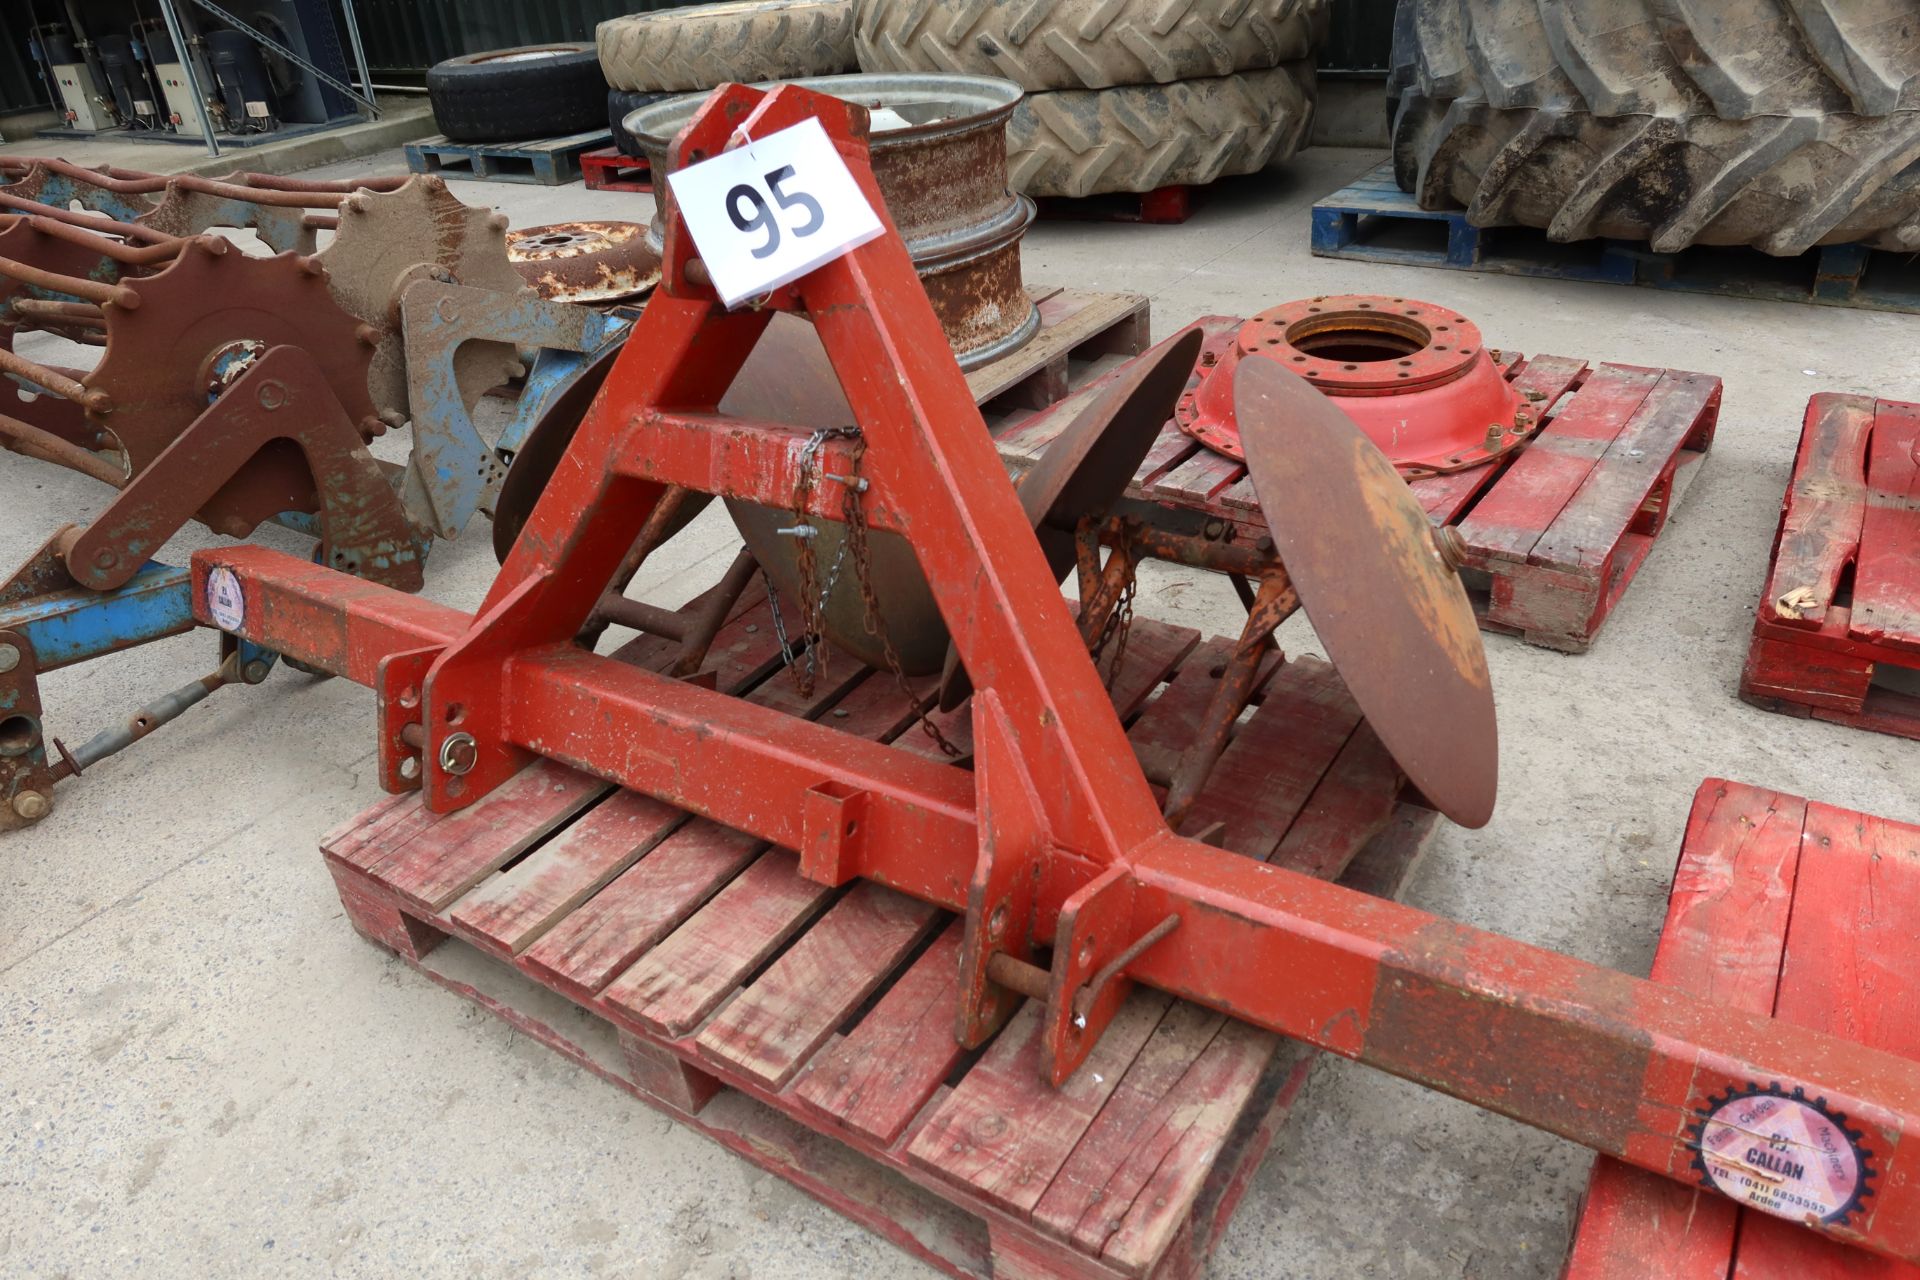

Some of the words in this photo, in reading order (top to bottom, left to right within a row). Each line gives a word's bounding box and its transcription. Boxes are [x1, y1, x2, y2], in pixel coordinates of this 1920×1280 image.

[725, 163, 825, 260] 95
[1739, 1099, 1775, 1124] Garden
[1746, 1147, 1804, 1181] CALLAN
[1818, 1126, 1846, 1181] Machinery
[1739, 1176, 1769, 1194] (041)
[1772, 1189, 1826, 1214] 6853555
[1749, 1191, 1781, 1209] Ardee
